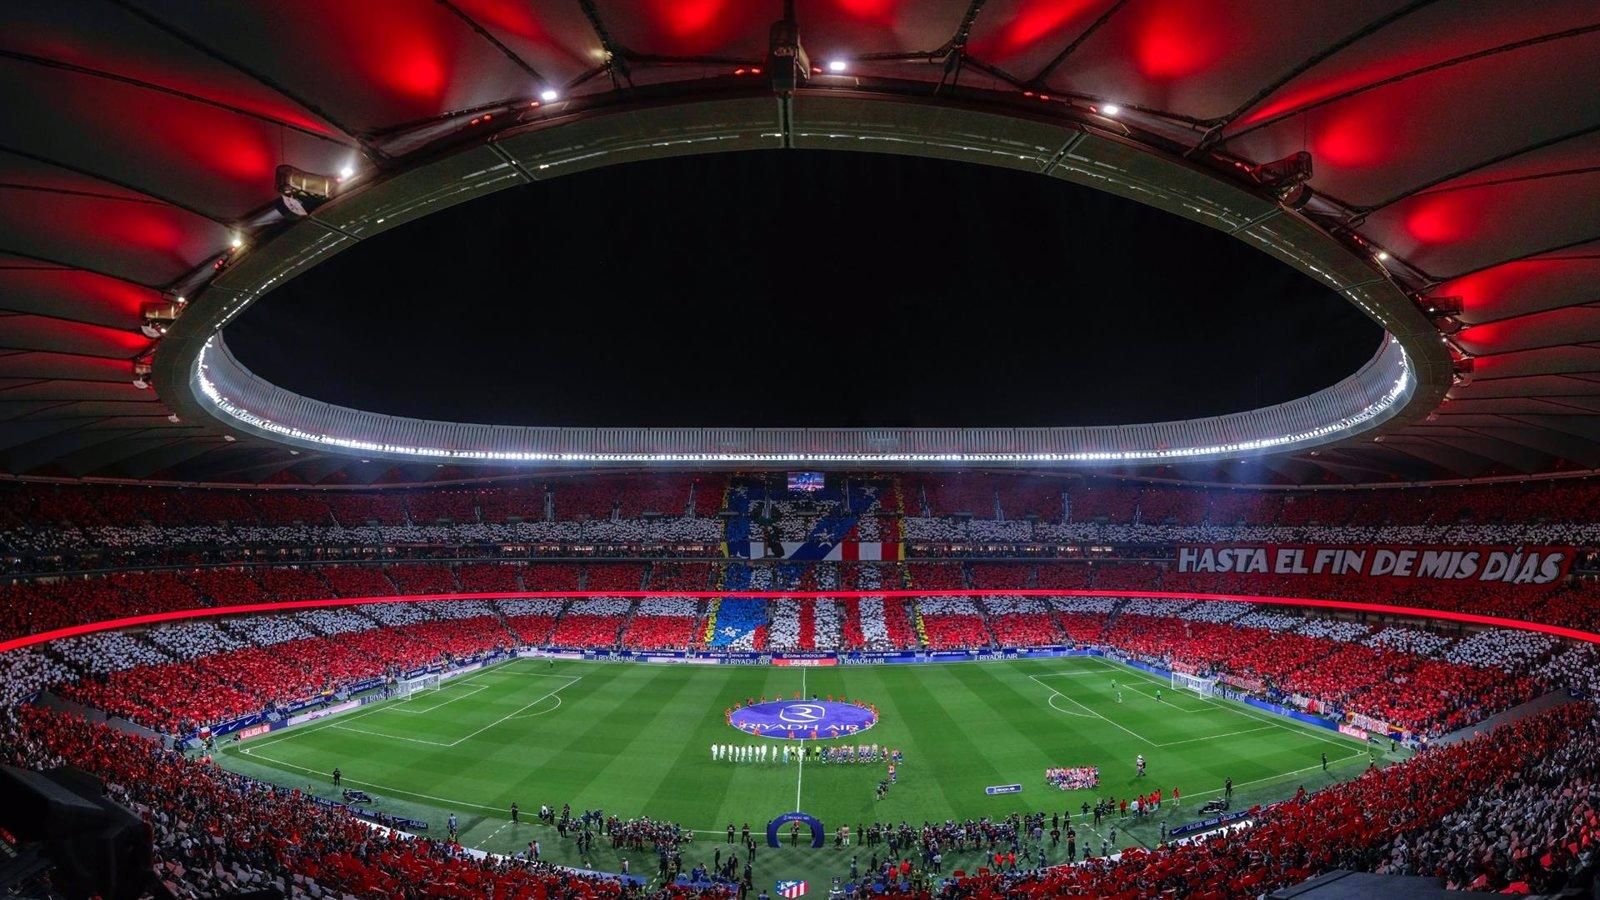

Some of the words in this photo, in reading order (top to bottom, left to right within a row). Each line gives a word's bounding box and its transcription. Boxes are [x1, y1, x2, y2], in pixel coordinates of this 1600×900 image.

[1178, 547, 1269, 574] HASTA
[1274, 548, 1309, 575] EL
[1312, 549, 1366, 576] FIN
[1370, 549, 1417, 577] DE
[1416, 550, 1481, 580] MIS
[1479, 546, 1565, 585] DÍAS
[1213, 686, 1234, 700] RIYDH
[743, 722, 818, 731] RIYADH
[825, 723, 860, 731] AIR
[241, 728, 262, 739] LALIGA
